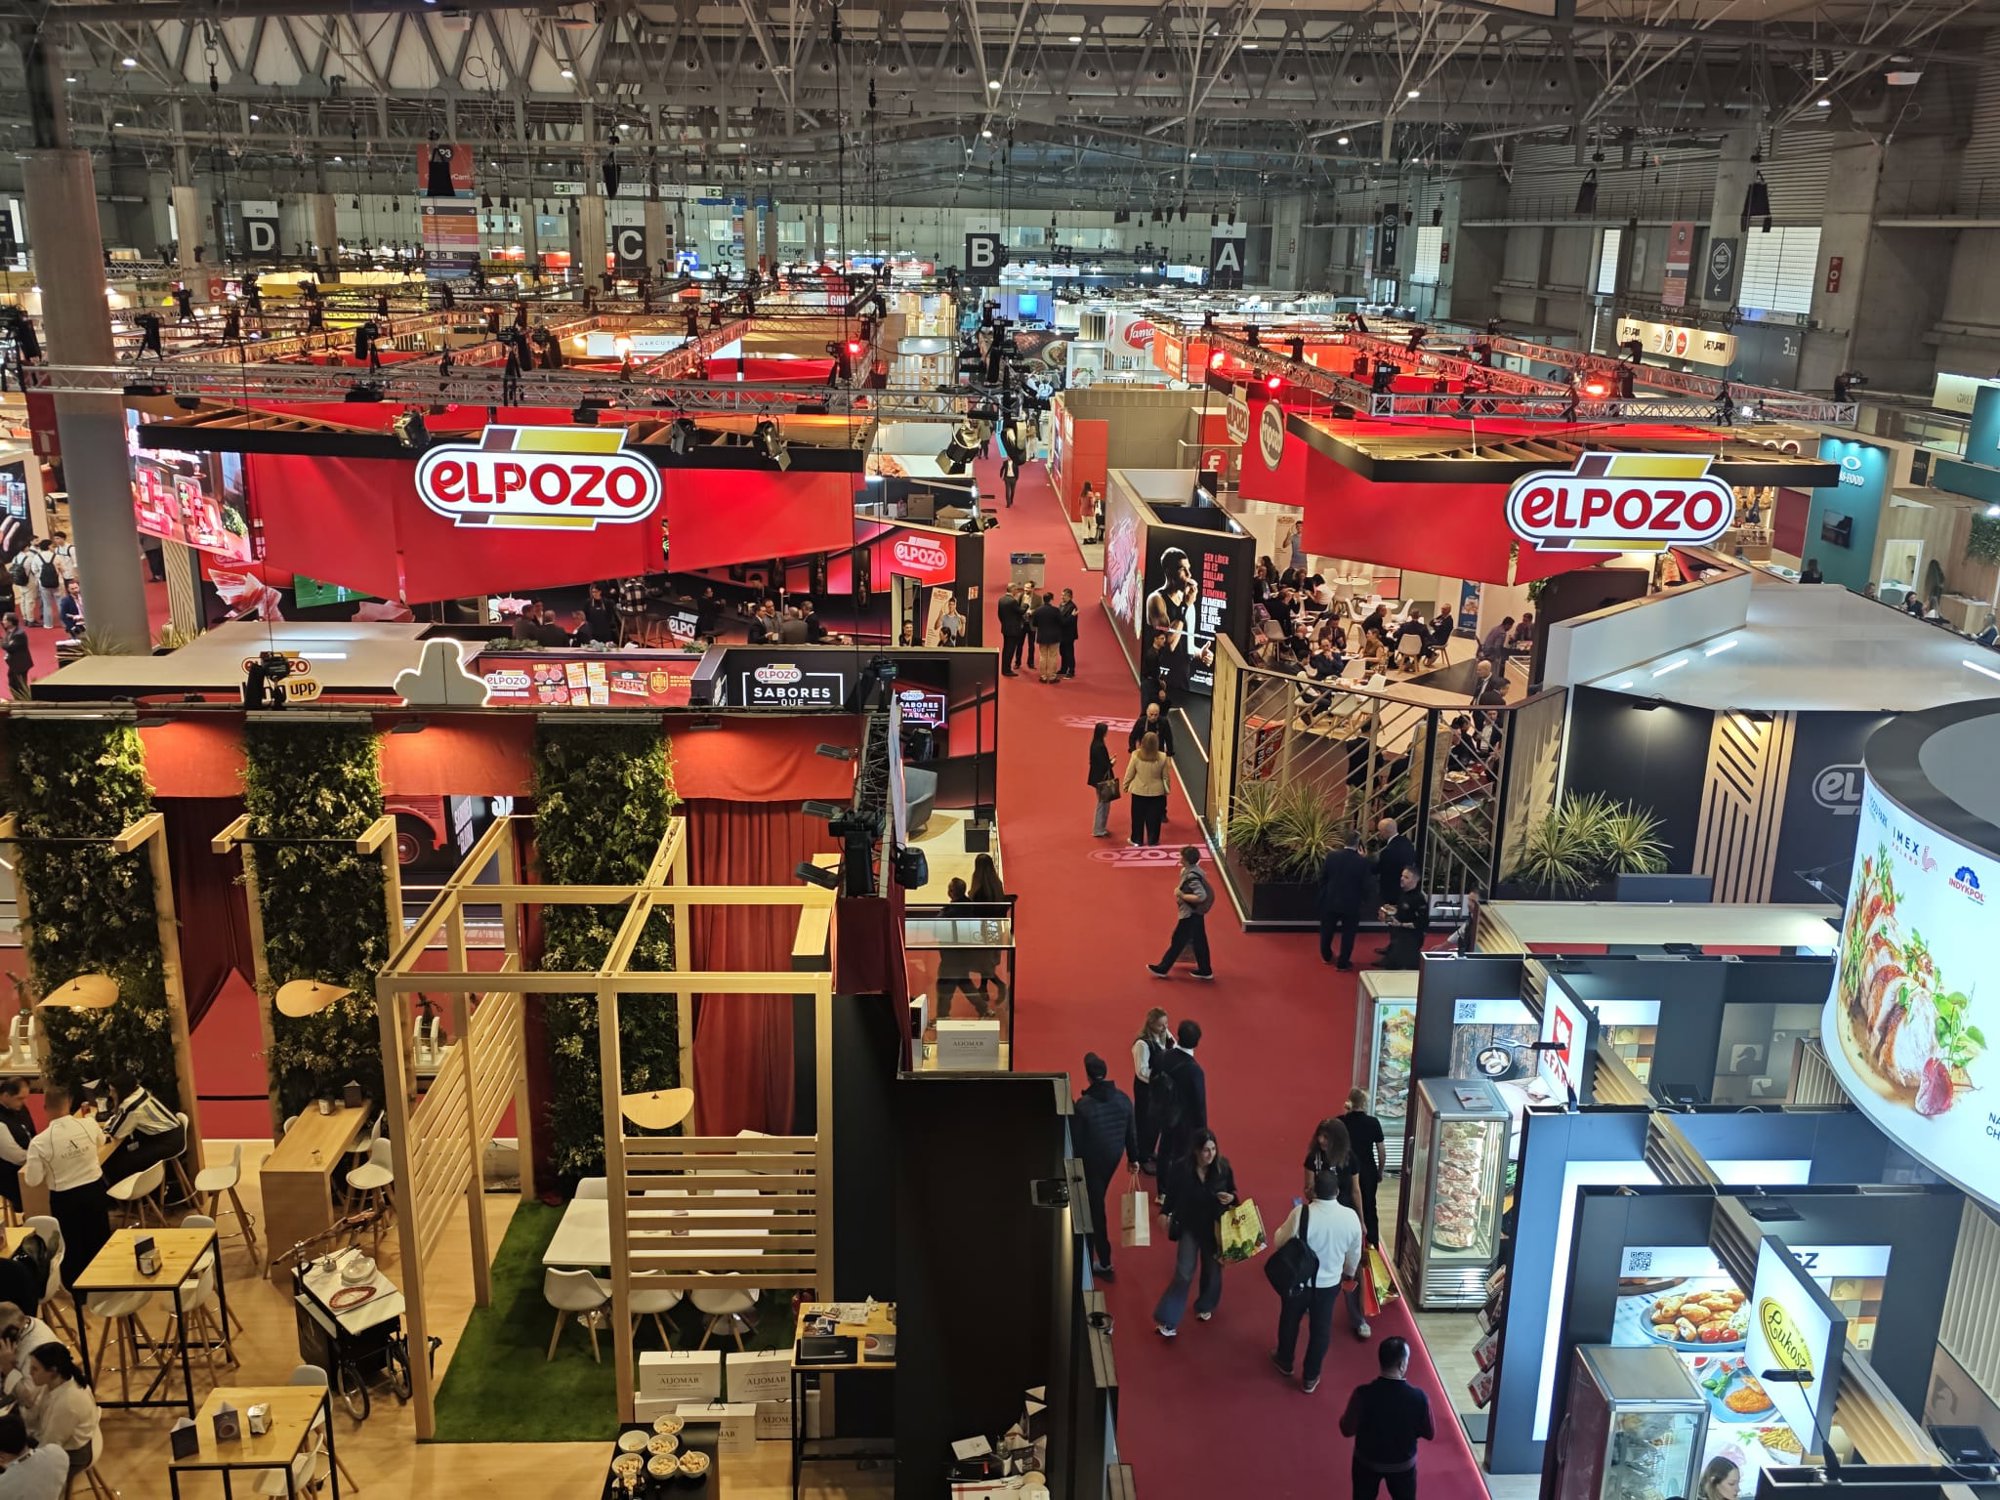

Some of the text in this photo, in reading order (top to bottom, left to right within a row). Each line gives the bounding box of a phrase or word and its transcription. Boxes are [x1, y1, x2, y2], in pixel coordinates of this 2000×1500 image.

[249, 221, 276, 252] D
[617, 230, 644, 261] C
[971, 237, 995, 268] B
[1215, 242, 1241, 272] A
[290, 681, 318, 696] upp
[753, 687, 831, 699] SABORES
[1892, 826, 1920, 857] IMEX
[1948, 876, 1985, 903] INDYKPOL
